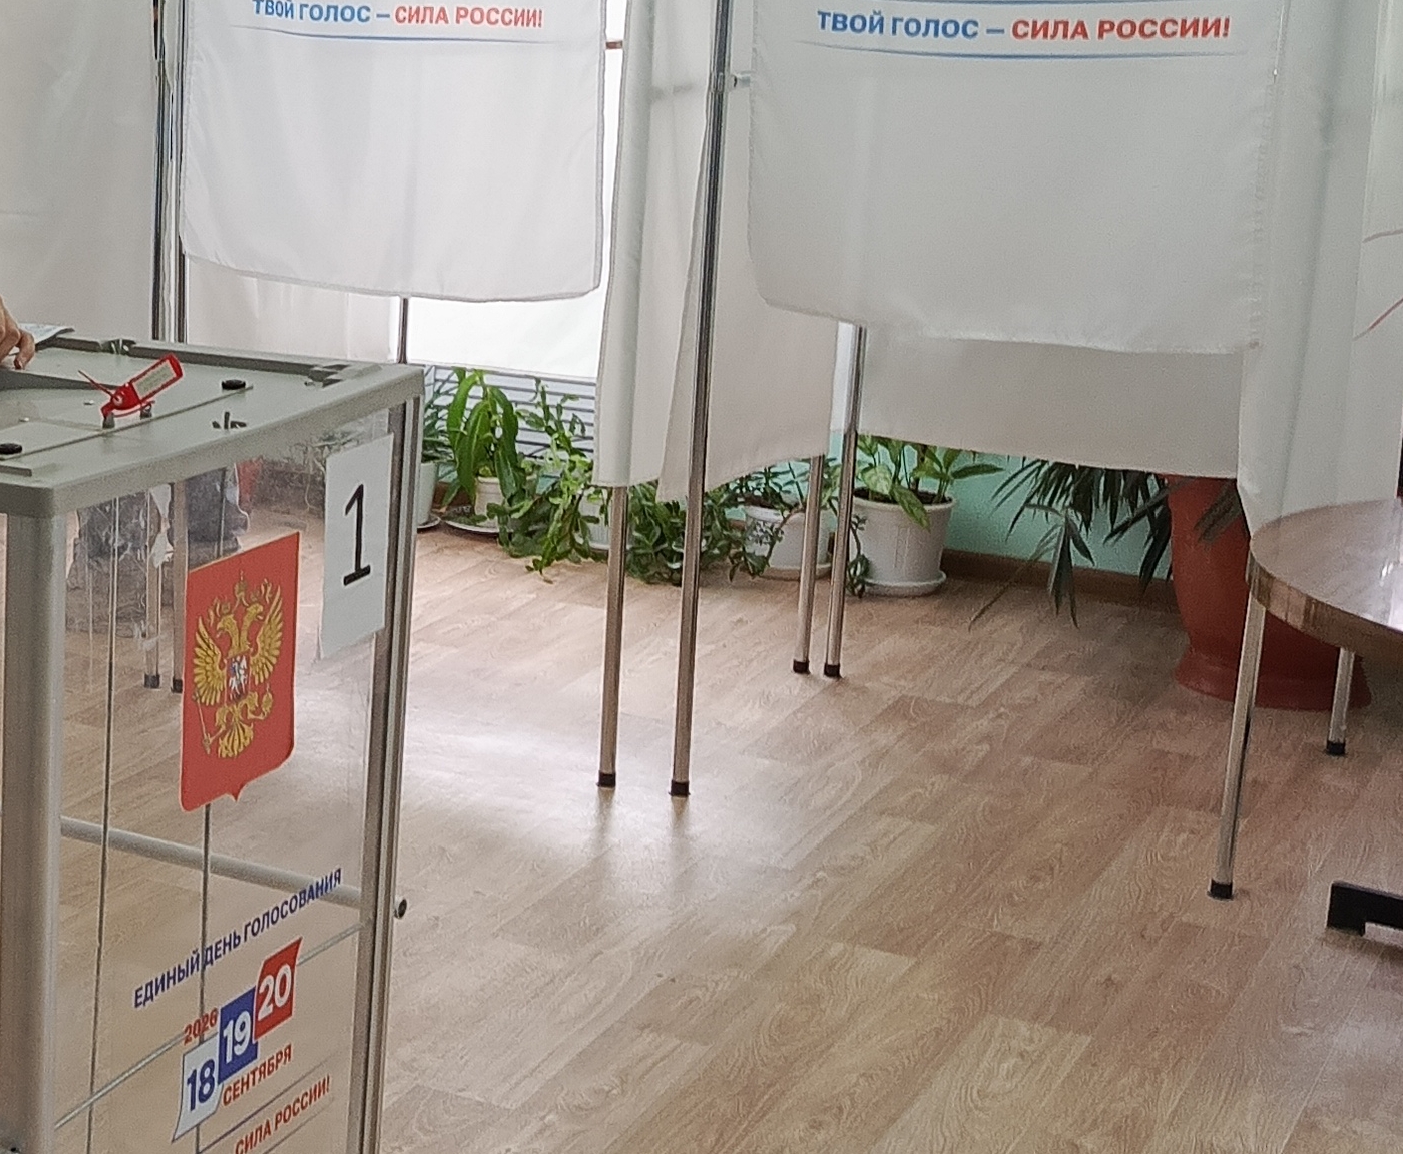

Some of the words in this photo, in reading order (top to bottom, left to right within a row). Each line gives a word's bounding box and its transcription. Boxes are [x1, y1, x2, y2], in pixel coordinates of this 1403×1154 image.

[299, 4, 371, 23] ГОЛОС
[395, 6, 448, 24] СИЛА
[455, 7, 543, 28] РОССИИ!
[817, 9, 884, 34] ТВОЙ
[891, 18, 979, 39] ГОЛОС
[1011, 19, 1088, 40] СИЛА
[1098, 17, 1230, 39] РОССИИ!
[343, 483, 372, 587] 1
[134, 948, 200, 1008] ЕДИНЫЙ
[204, 929, 241, 967] ДЕНЬ
[244, 868, 341, 942] ГОЛОСОВАНИЯ
[184, 1008, 218, 1045] 2026
[187, 1059, 215, 1112] 18
[223, 1010, 251, 1064] 19
[258, 963, 292, 1021] 20
[223, 1043, 291, 1106] СЕНТЯБРЯ
[235, 1119, 271, 1154] СИЛА
[274, 1074, 330, 1131] РОССИИ!
